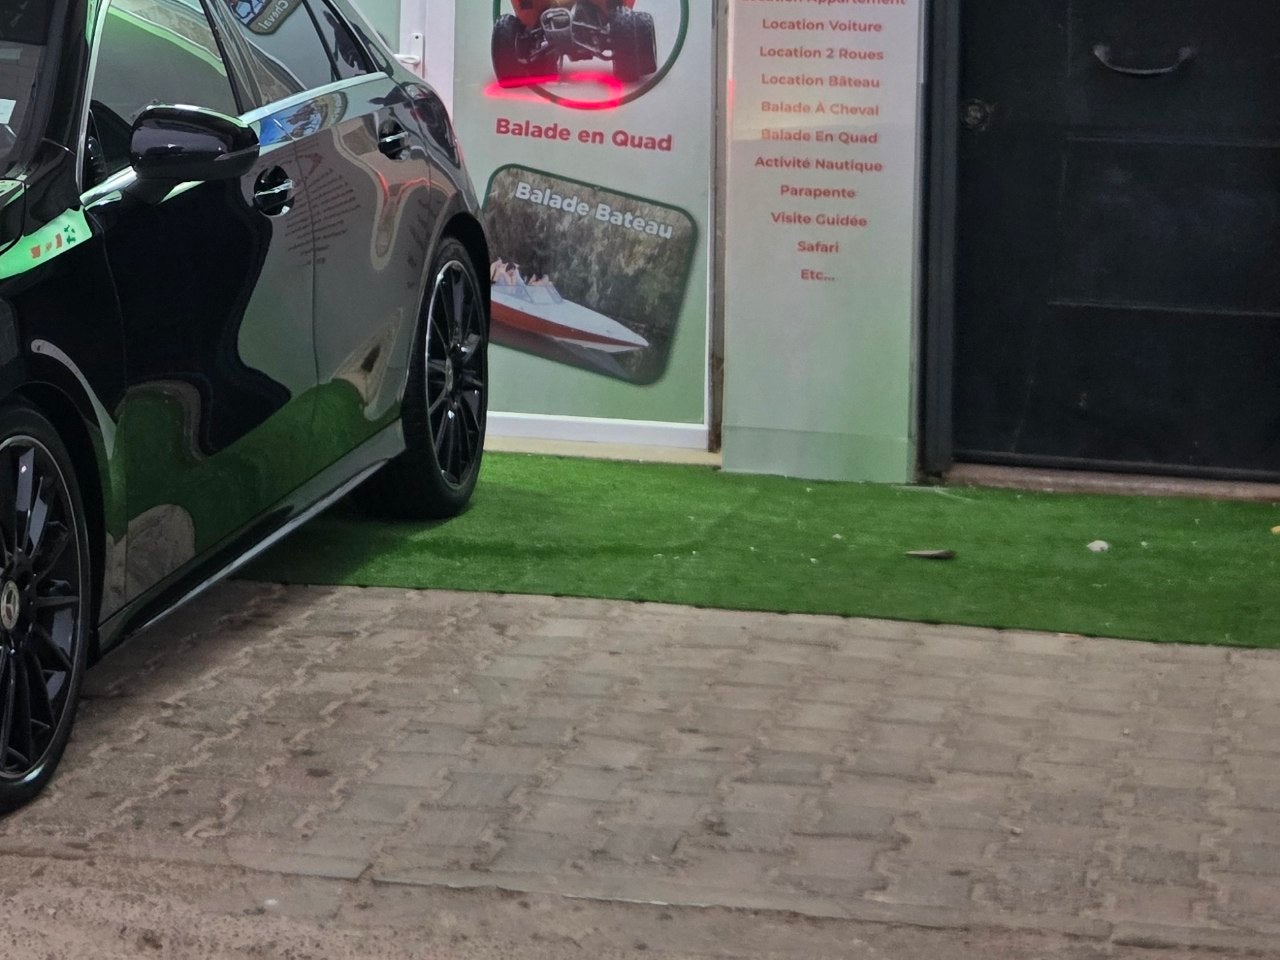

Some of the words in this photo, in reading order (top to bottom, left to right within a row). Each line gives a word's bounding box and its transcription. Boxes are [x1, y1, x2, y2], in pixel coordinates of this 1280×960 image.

[762, 19, 825, 31] Location
[828, 20, 883, 33] Voiture
[759, 46, 822, 59] Location
[825, 48, 835, 59] 2
[838, 48, 885, 61] Roues
[761, 74, 824, 87] Location
[828, 74, 881, 89] Bâteau
[761, 101, 811, 115] Balade
[831, 103, 880, 117] Cheval
[495, 118, 571, 140] Balade
[578, 129, 604, 144] en
[612, 129, 673, 152] Quad
[761, 129, 811, 142] Balade
[815, 130, 834, 143] En
[838, 131, 878, 145] Quad
[754, 156, 811, 169] Activité
[815, 158, 883, 173] Nautique
[780, 184, 856, 200] Parapente
[515, 181, 590, 216] Balade
[594, 203, 673, 239] Bateau
[770, 212, 812, 225] Visite
[815, 213, 868, 228] Guidée
[797, 240, 839, 254] Safari
[800, 269, 835, 281] Etc...
